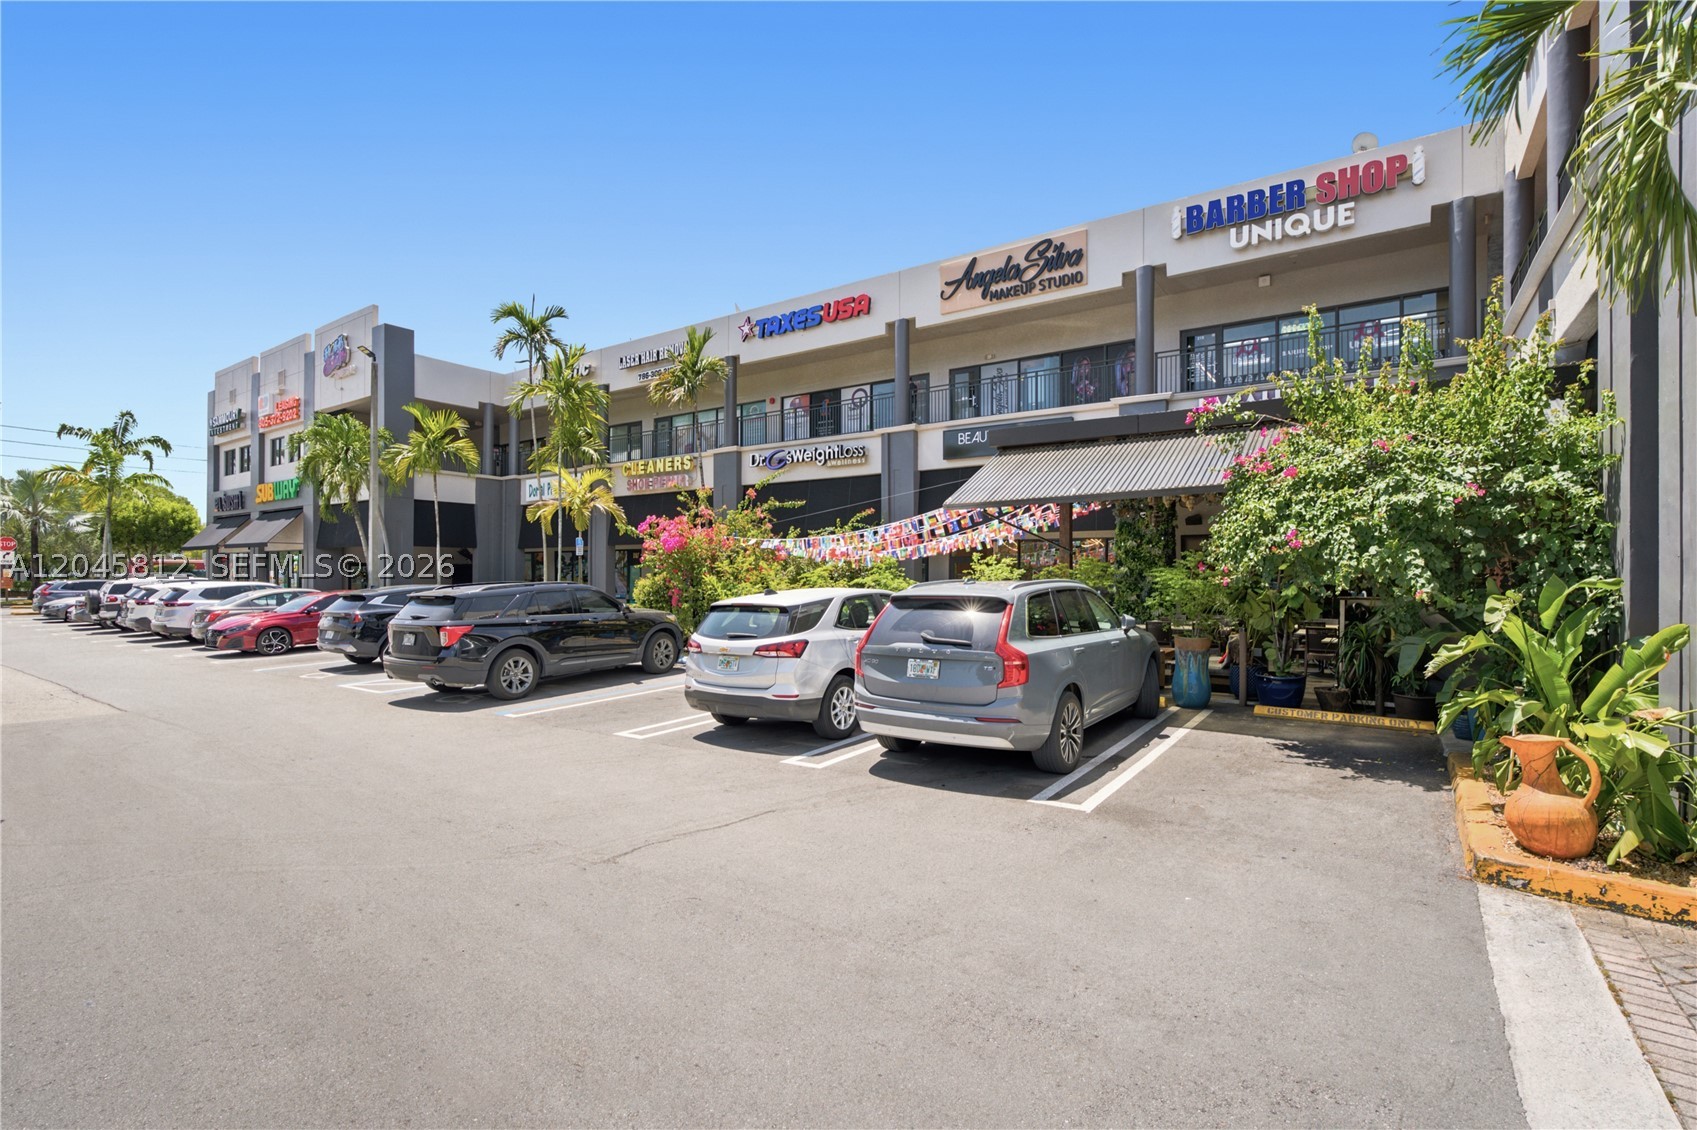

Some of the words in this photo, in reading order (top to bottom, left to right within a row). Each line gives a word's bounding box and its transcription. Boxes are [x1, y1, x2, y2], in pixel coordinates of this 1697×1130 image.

[1186, 178, 1306, 236] BARBER
[1315, 153, 1408, 204] SHOP
[1229, 201, 1355, 249] UNIQUE
[940, 257, 1022, 300] Angela
[1020, 238, 1084, 282] Silva
[989, 281, 1037, 301] MAKEUP
[1039, 271, 1084, 292] STUDIO
[755, 304, 823, 339] TAXES
[822, 294, 871, 323] USA
[619, 353, 641, 370] LASER
[641, 348, 658, 364] HAIR
[958, 430, 989, 445] BEAU
[622, 455, 693, 477] CLEANERS
[256, 477, 300, 504] SUBWAY
[528, 483, 545, 498] Dorl
[1267, 707, 1328, 719] CUSTOMER
[1331, 712, 1385, 726] PARKING
[1389, 717, 1421, 729] ONLY
